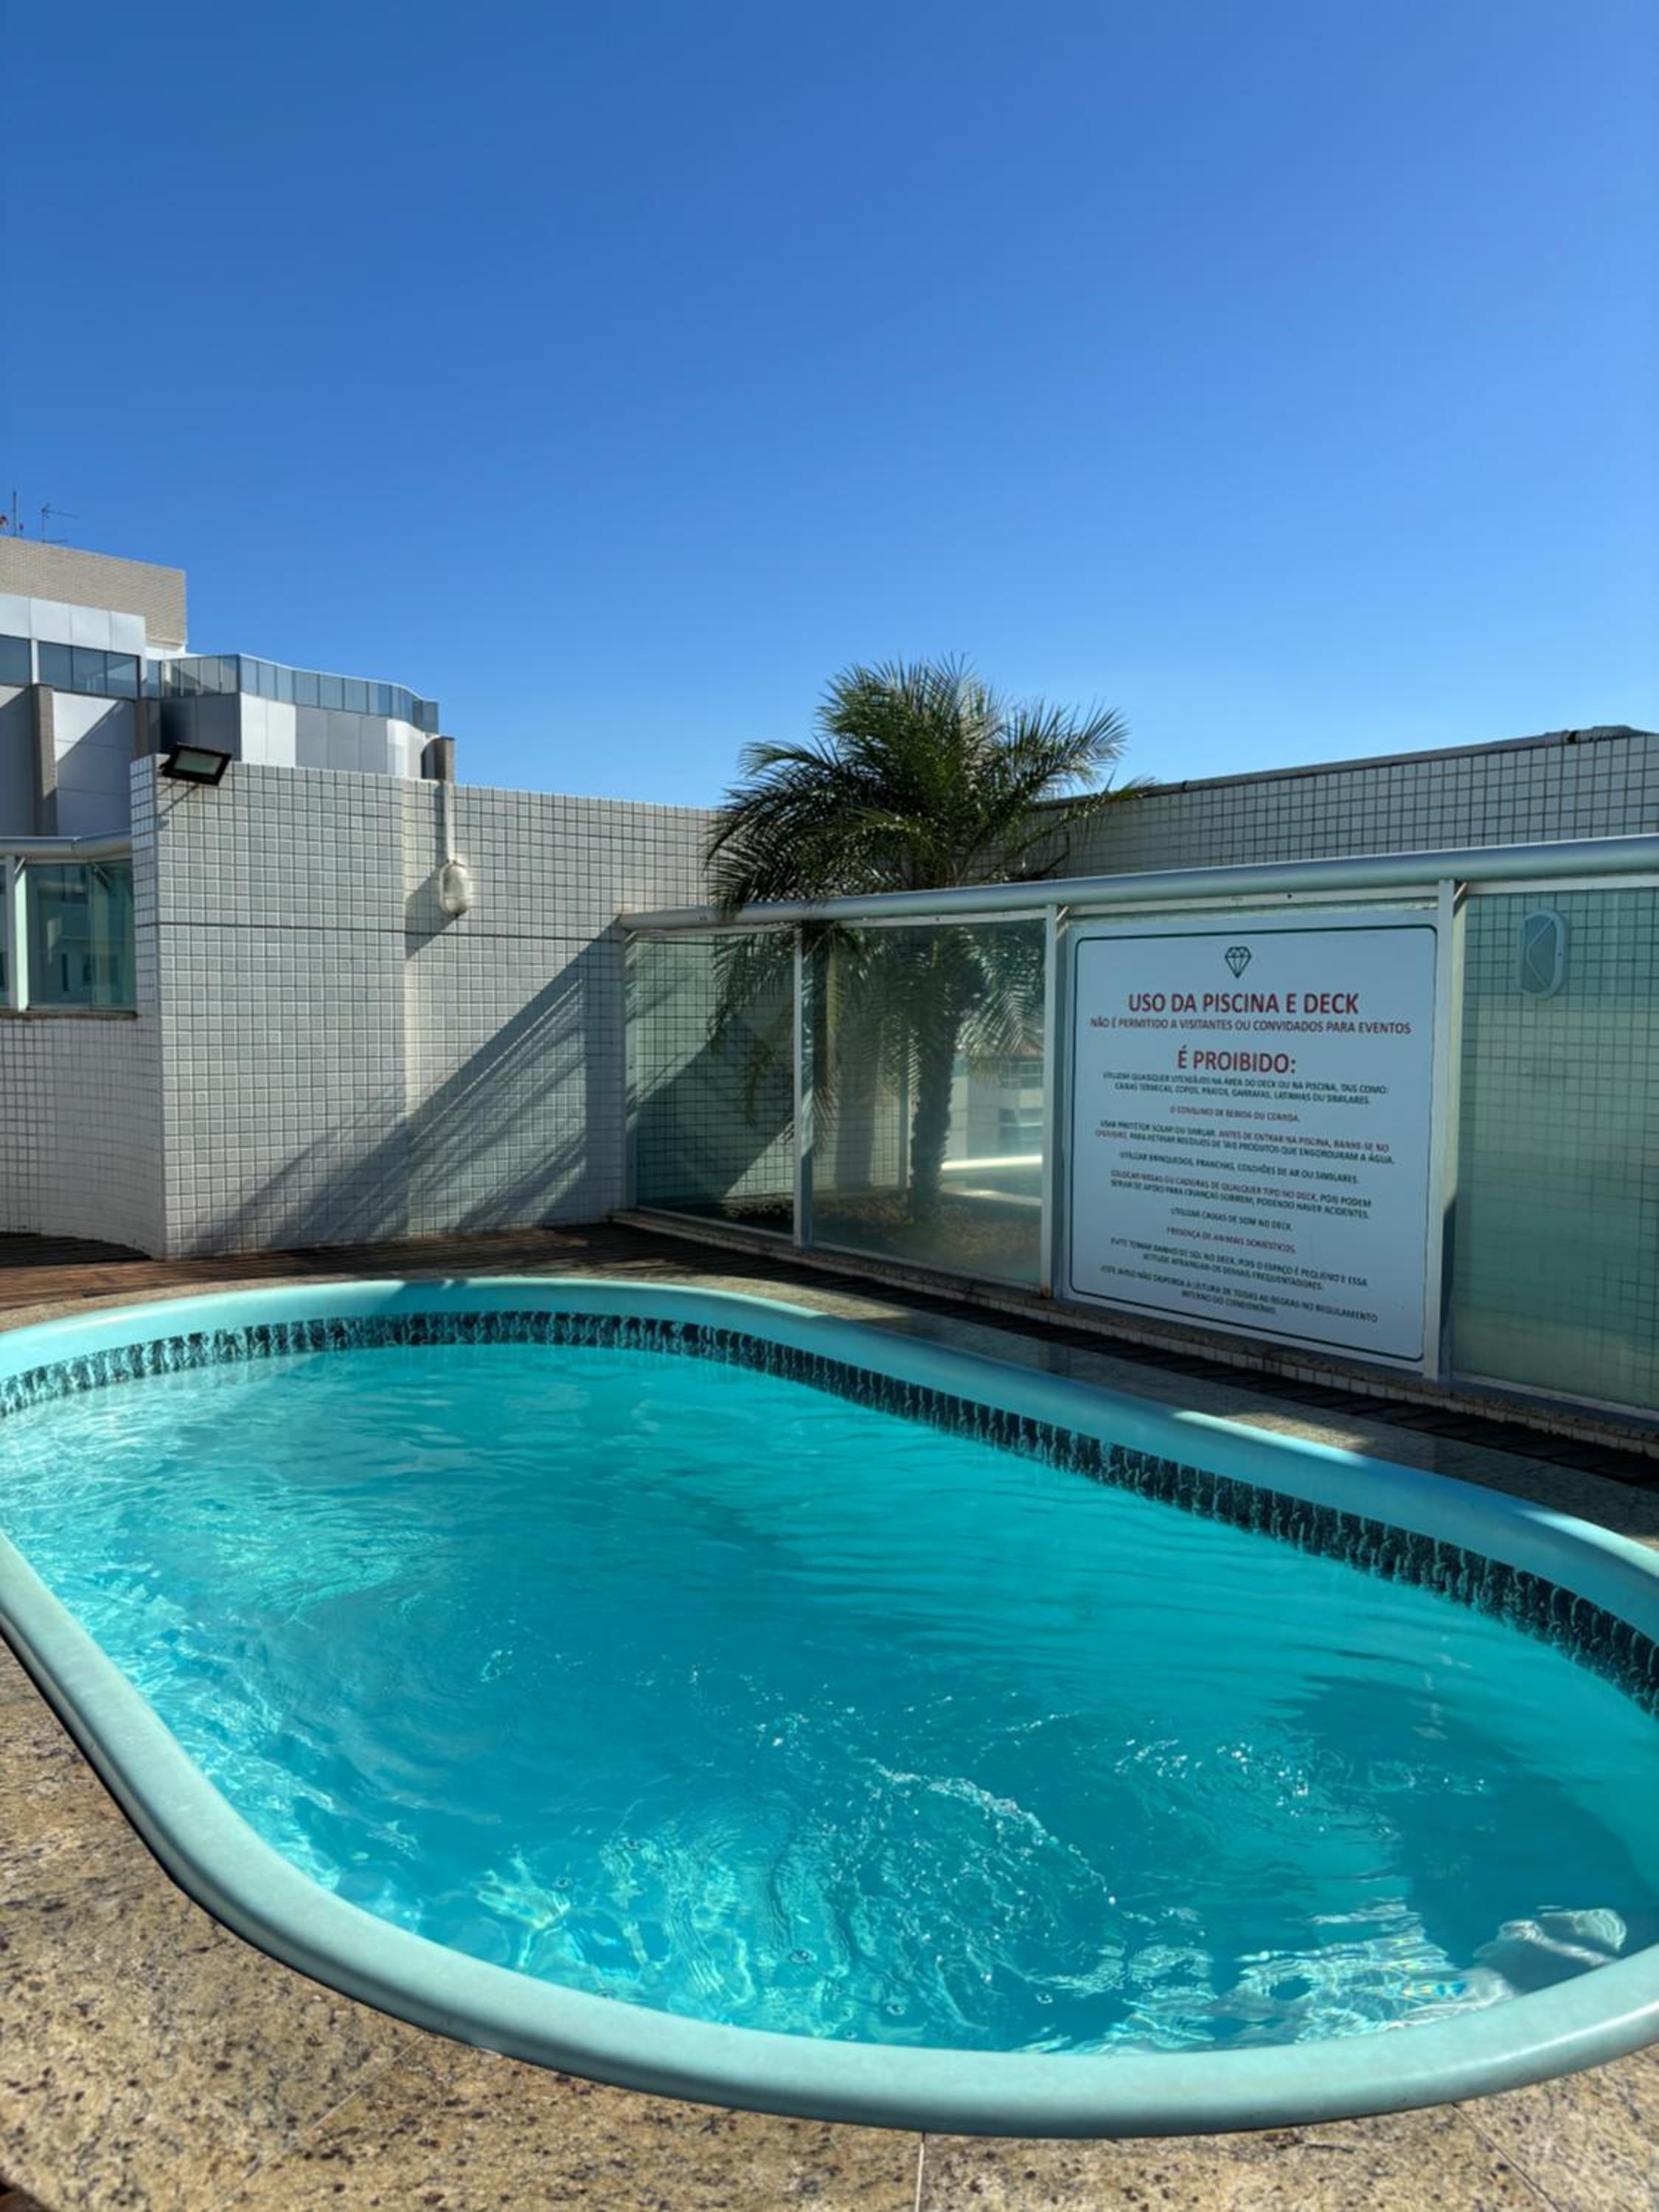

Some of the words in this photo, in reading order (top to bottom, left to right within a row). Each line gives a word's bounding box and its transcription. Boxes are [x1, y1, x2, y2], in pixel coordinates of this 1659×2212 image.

[1129, 993, 1166, 1012] USO
[1171, 993, 1197, 1012] DA
[1203, 992, 1279, 1013] PISCINA
[1286, 993, 1296, 1013] E
[1304, 992, 1359, 1014] DECK
[1091, 1016, 1110, 1028] NÃO
[1112, 1017, 1116, 1028] É
[1119, 1018, 1168, 1028] PERMITIDO
[1171, 1019, 1178, 1028] A
[1180, 1019, 1232, 1030] VISITANTES
[1235, 1020, 1251, 1030] OU
[1253, 1020, 1324, 1032] CONVIDADOS
[1326, 1021, 1355, 1032] PARA
[1358, 1022, 1411, 1034] EVENTOS
[1178, 1044, 1187, 1068] É
[1193, 1050, 1295, 1073] PROIBIDO:
[1244, 1079, 1256, 1088] DO
[1257, 1079, 1276, 1088] DECK
[1278, 1080, 1290, 1089] OU
[1292, 1081, 1304, 1089] NA
[1340, 1083, 1357, 1092] TAIS
[1274, 1091, 1311, 1101] LATINHAS
[1312, 1093, 1324, 1102] OU
[1253, 1111, 1265, 1120] OU
[1239, 1143, 1279, 1153] PRODUTOS
[1281, 1147, 1298, 1155] QUE
[1360, 1152, 1367, 1161] A
[1377, 1143, 1389, 1152] NO
[1277, 1168, 1287, 1177] DE
[1289, 1169, 1301, 1178] AR
[1302, 1170, 1315, 1179] OU
[1221, 1183, 1262, 1194] QUALQUER
[1263, 1187, 1281, 1197] TIPO
[1283, 1189, 1295, 1198] NO
[1320, 1193, 1338, 1204] POIS
[1340, 1196, 1371, 1207] PODEM
[1256, 1197, 1295, 1209] PODENDO
[1296, 1203, 1322, 1214] HAVER
[1228, 1214, 1237, 1223] DE
[1239, 1216, 1256, 1226] SOM
[1258, 1219, 1270, 1228] NO
[1203, 1253, 1215, 1262] NO
[1238, 1257, 1255, 1269] POIS
[1256, 1262, 1263, 1270] O
[1347, 1276, 1368, 1287] ESSA
[1301, 1300, 1314, 1311] NO
[1315, 1303, 1378, 1323] REGULAMENTO
